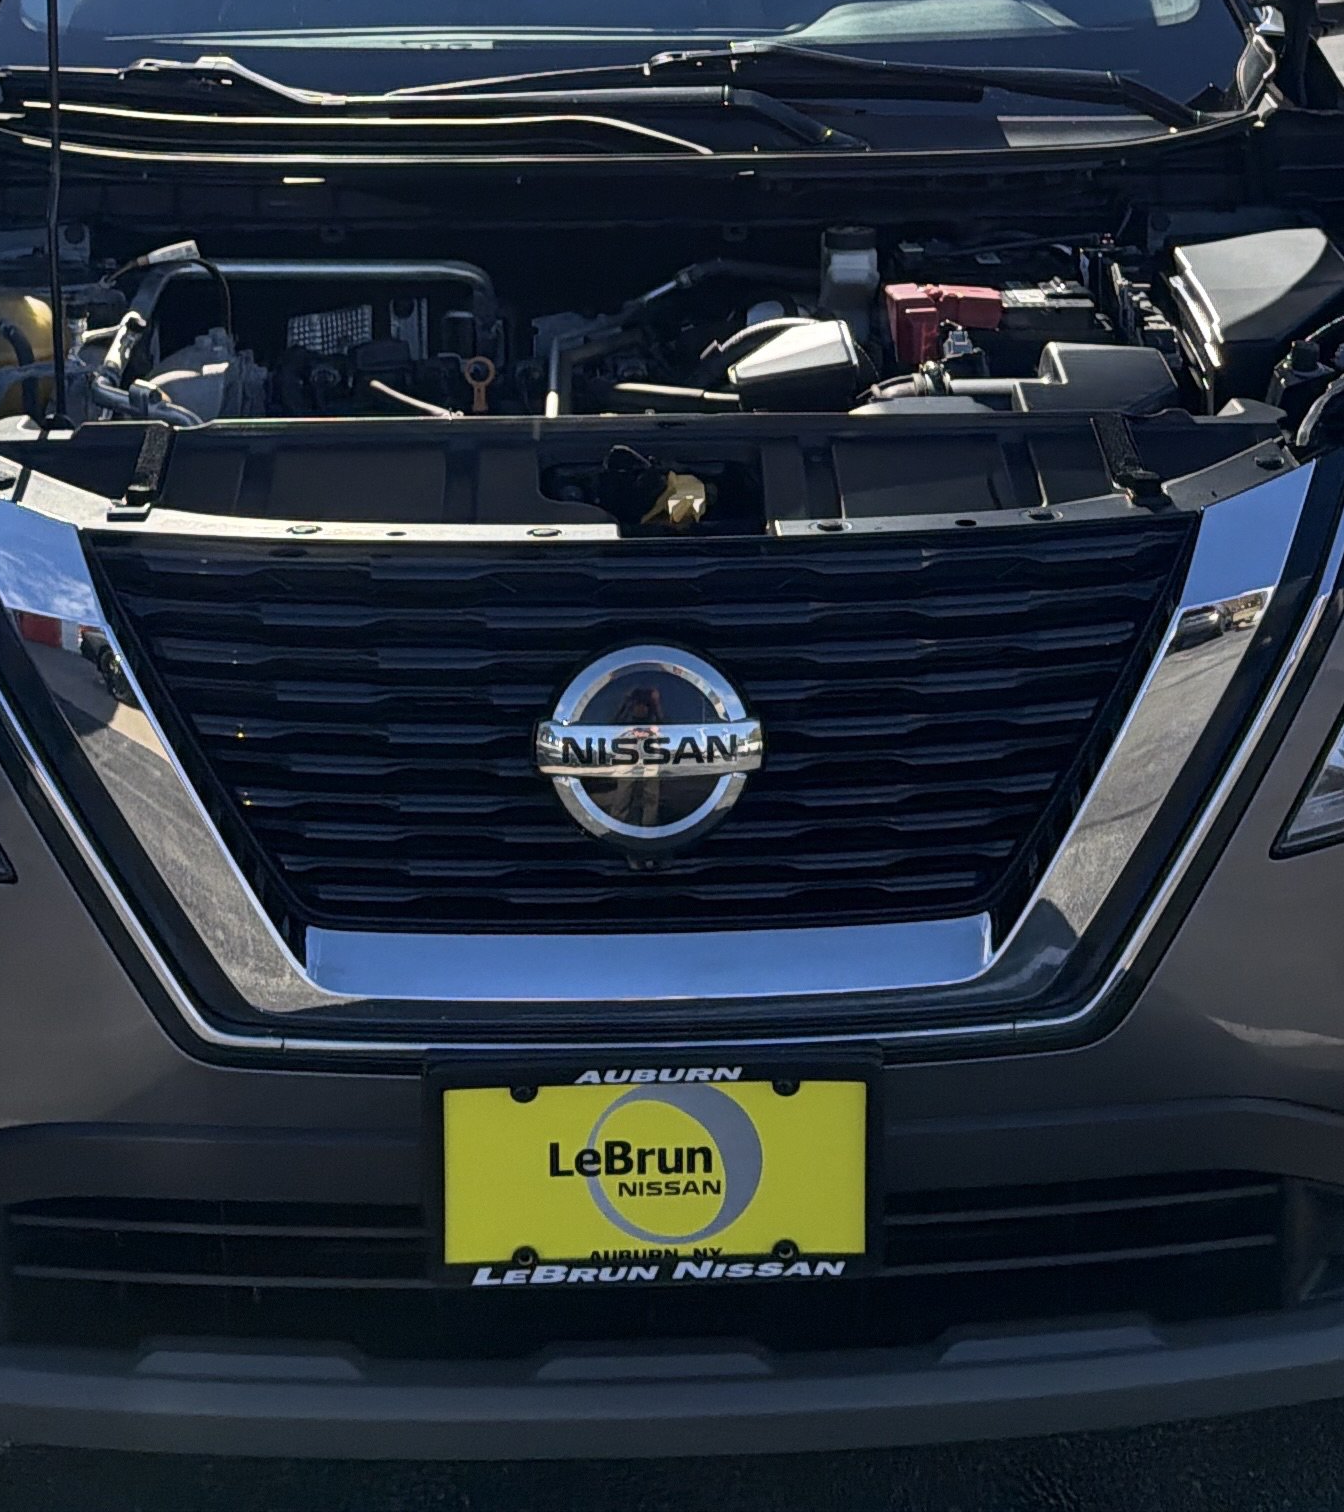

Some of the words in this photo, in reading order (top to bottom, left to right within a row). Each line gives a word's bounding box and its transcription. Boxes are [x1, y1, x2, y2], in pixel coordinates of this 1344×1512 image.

[561, 734, 738, 766] NISSAN
[574, 1066, 743, 1084] AUBURN
[549, 1140, 713, 1178] LeBrun
[618, 1180, 722, 1197] NISSAN
[671, 1259, 847, 1280] NISSAN
